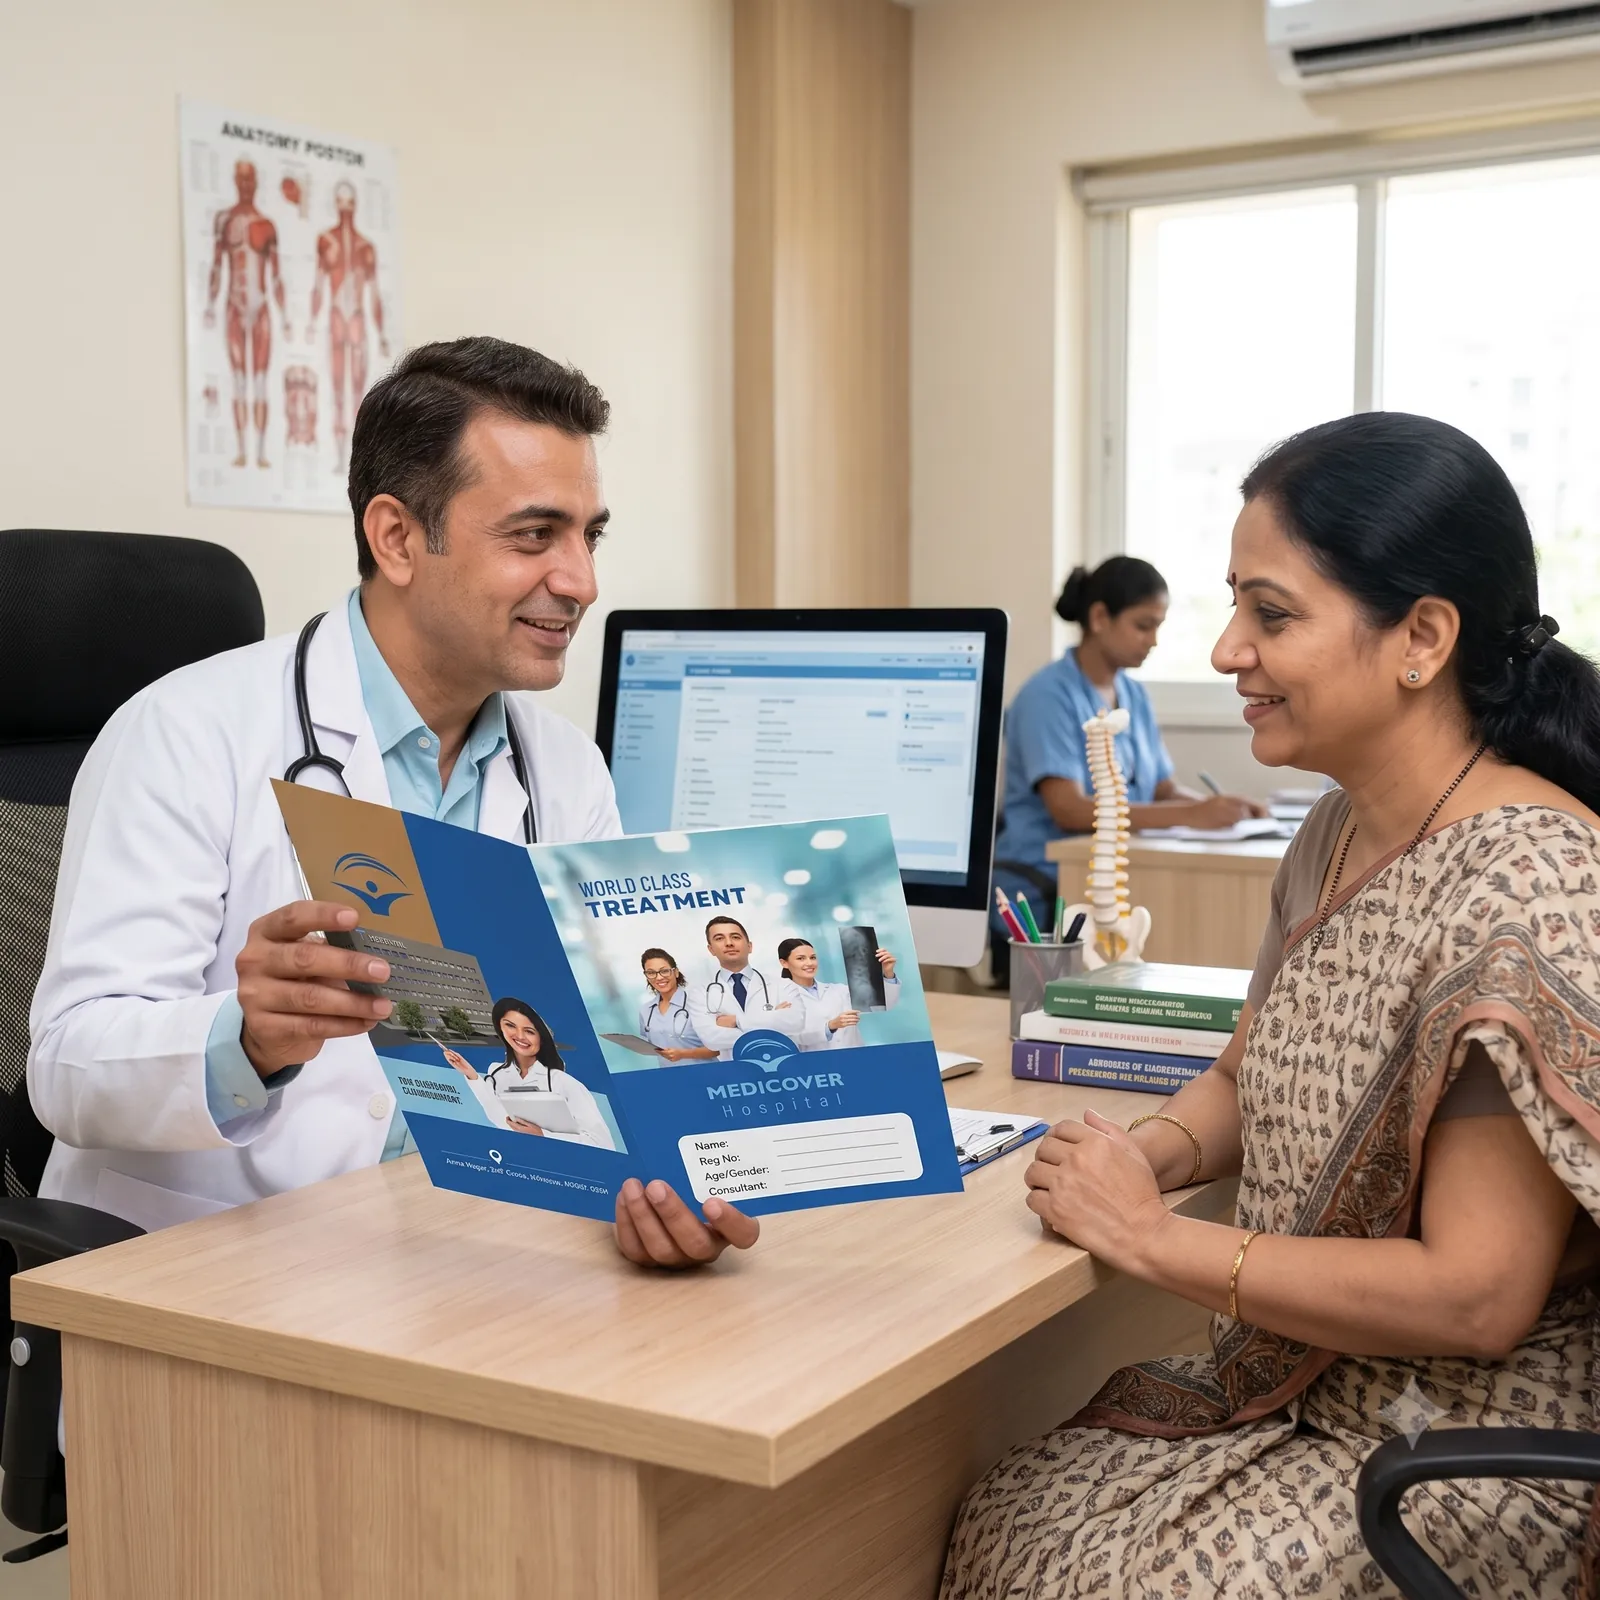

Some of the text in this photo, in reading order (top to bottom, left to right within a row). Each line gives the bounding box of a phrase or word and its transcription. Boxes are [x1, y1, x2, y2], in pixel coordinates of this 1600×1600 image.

[578, 872, 692, 897] WORLD CLASS
[585, 887, 745, 918] TREATMENT
[706, 1072, 845, 1100] MEDICOVER
[721, 1093, 842, 1118] Hospital
[694, 1139, 729, 1151] Name:
[699, 1153, 741, 1167] Reg No:
[704, 1166, 770, 1182] Age/Gender:
[708, 1180, 768, 1197] Consultant:
